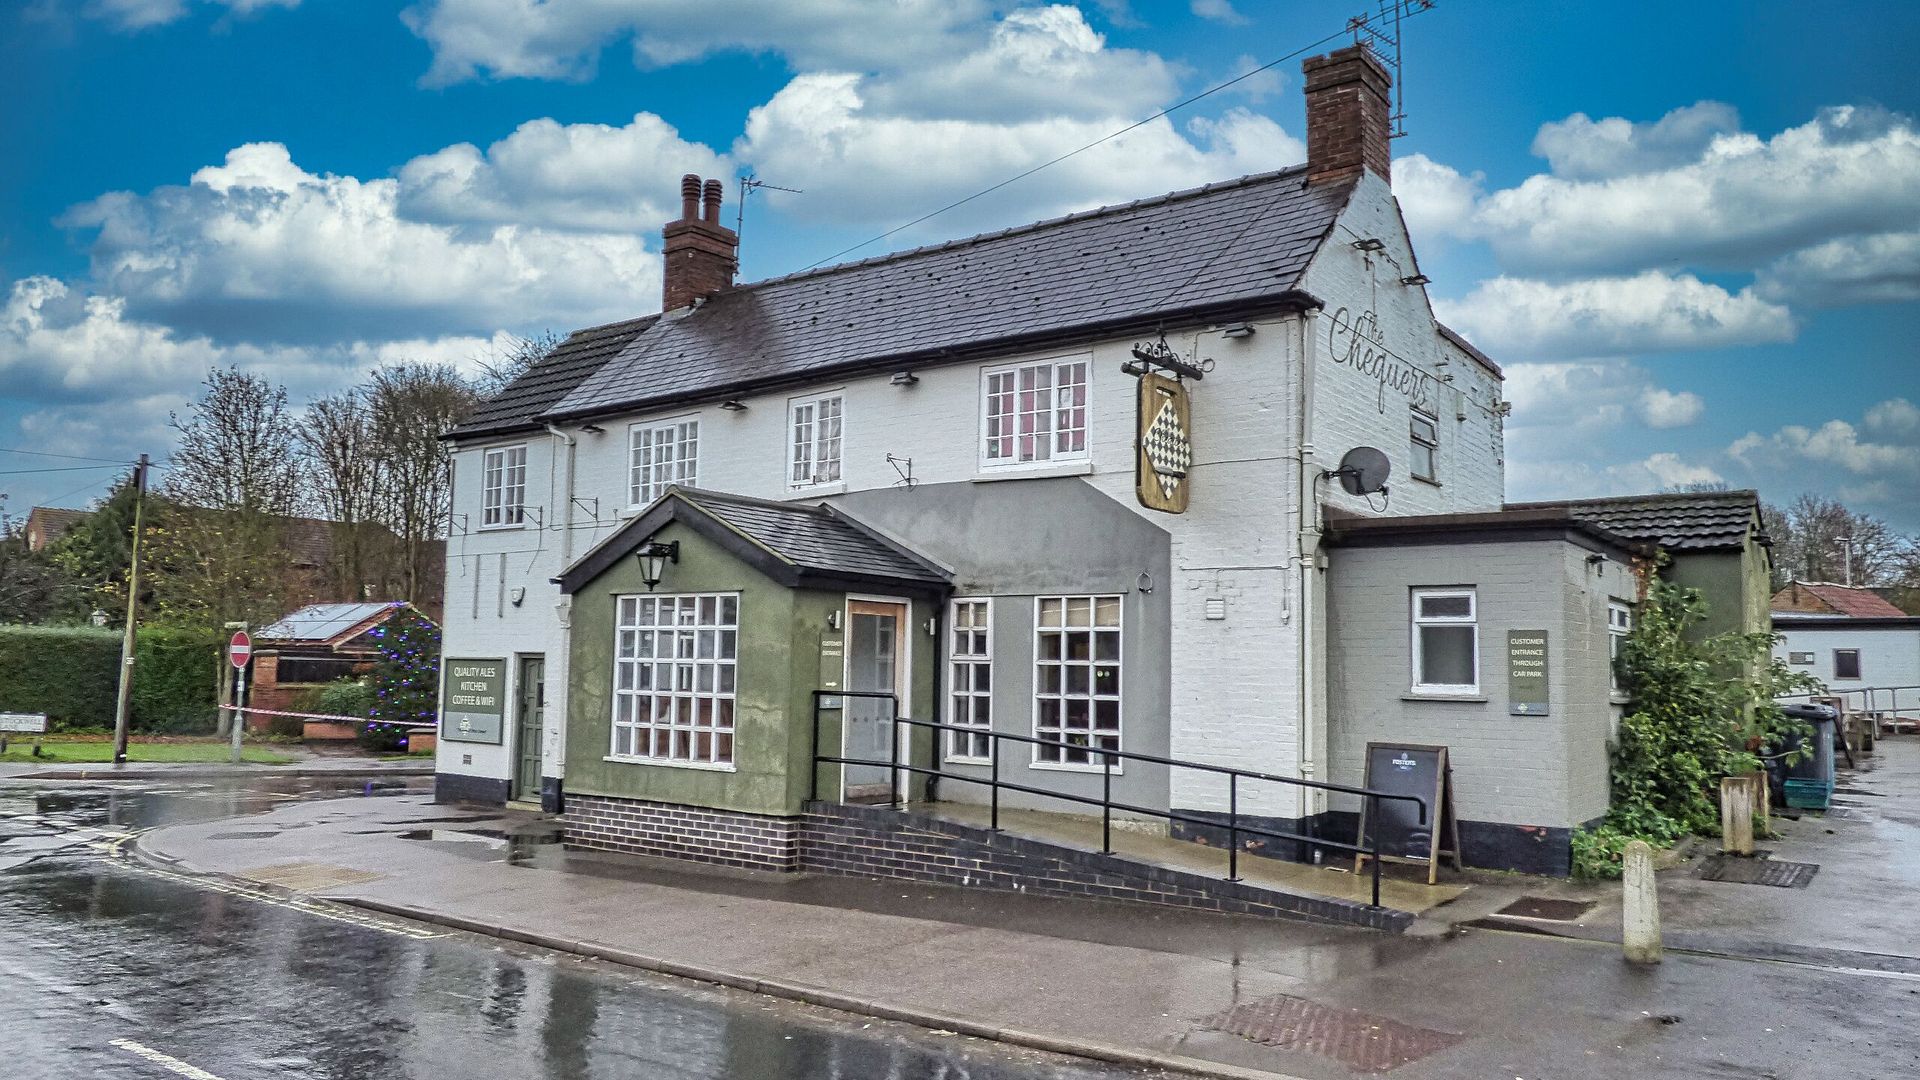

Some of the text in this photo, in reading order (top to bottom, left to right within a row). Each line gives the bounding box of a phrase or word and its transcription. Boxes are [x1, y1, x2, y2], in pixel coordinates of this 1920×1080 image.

[1363, 310, 1384, 346] The
[1329, 306, 1430, 415] Chequers
[453, 666, 496, 678] QUALITY ALES
[460, 681, 488, 692] KITCHEN
[452, 694, 496, 706] COFFEE & WIFI
